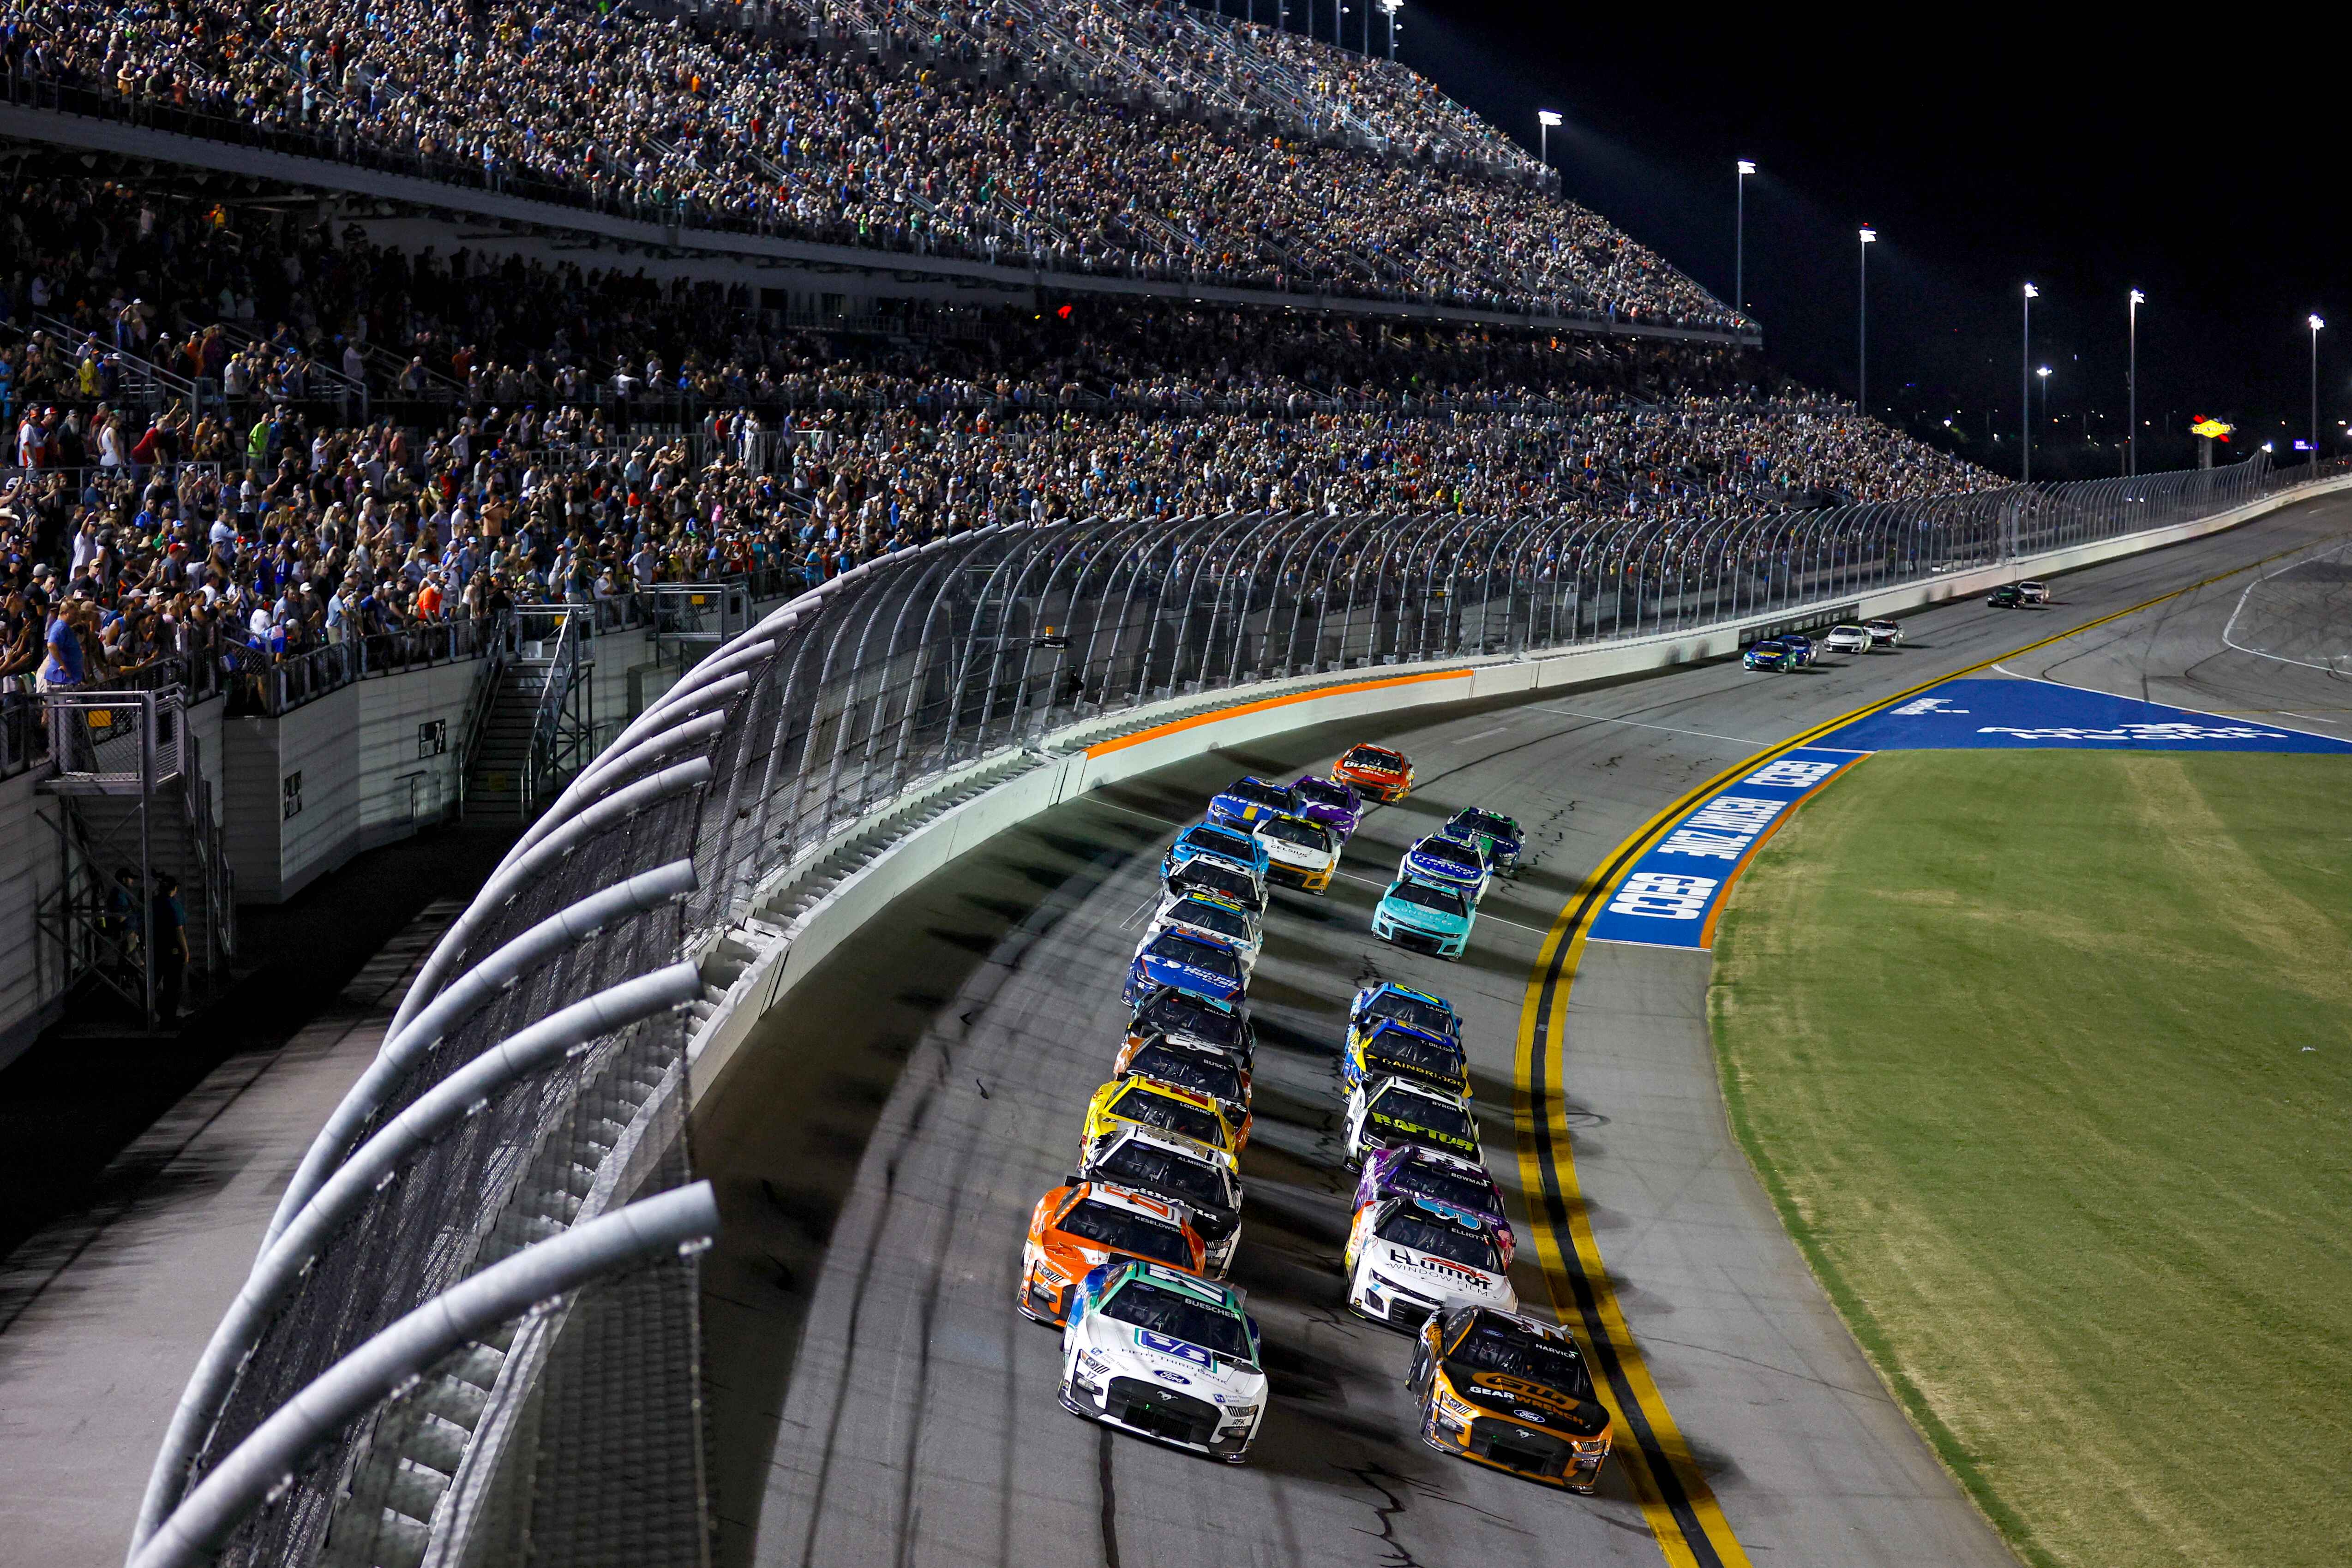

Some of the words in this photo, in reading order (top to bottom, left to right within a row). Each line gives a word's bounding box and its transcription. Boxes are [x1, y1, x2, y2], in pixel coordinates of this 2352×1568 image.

[1744, 760, 1838, 787] GEICO
[1684, 796, 1788, 834] RESTART
[1271, 845, 1308, 858] CELSIUS
[1657, 830, 1753, 860] ZONE
[1608, 872, 1718, 920] GEICO
[1179, 1102, 1211, 1116] LOGANO
[1432, 1101, 1457, 1112] BYRON
[1371, 1112, 1475, 1152] RAPTOR
[1389, 1262, 1452, 1281] WINDOW
[1457, 1280, 1488, 1297] FILM
[1086, 1371, 1097, 1379] 17
[1158, 1371, 1185, 1384] Ford
[1469, 1386, 1584, 1425] GEARWRENCH
[1519, 1411, 1539, 1422] Ford
